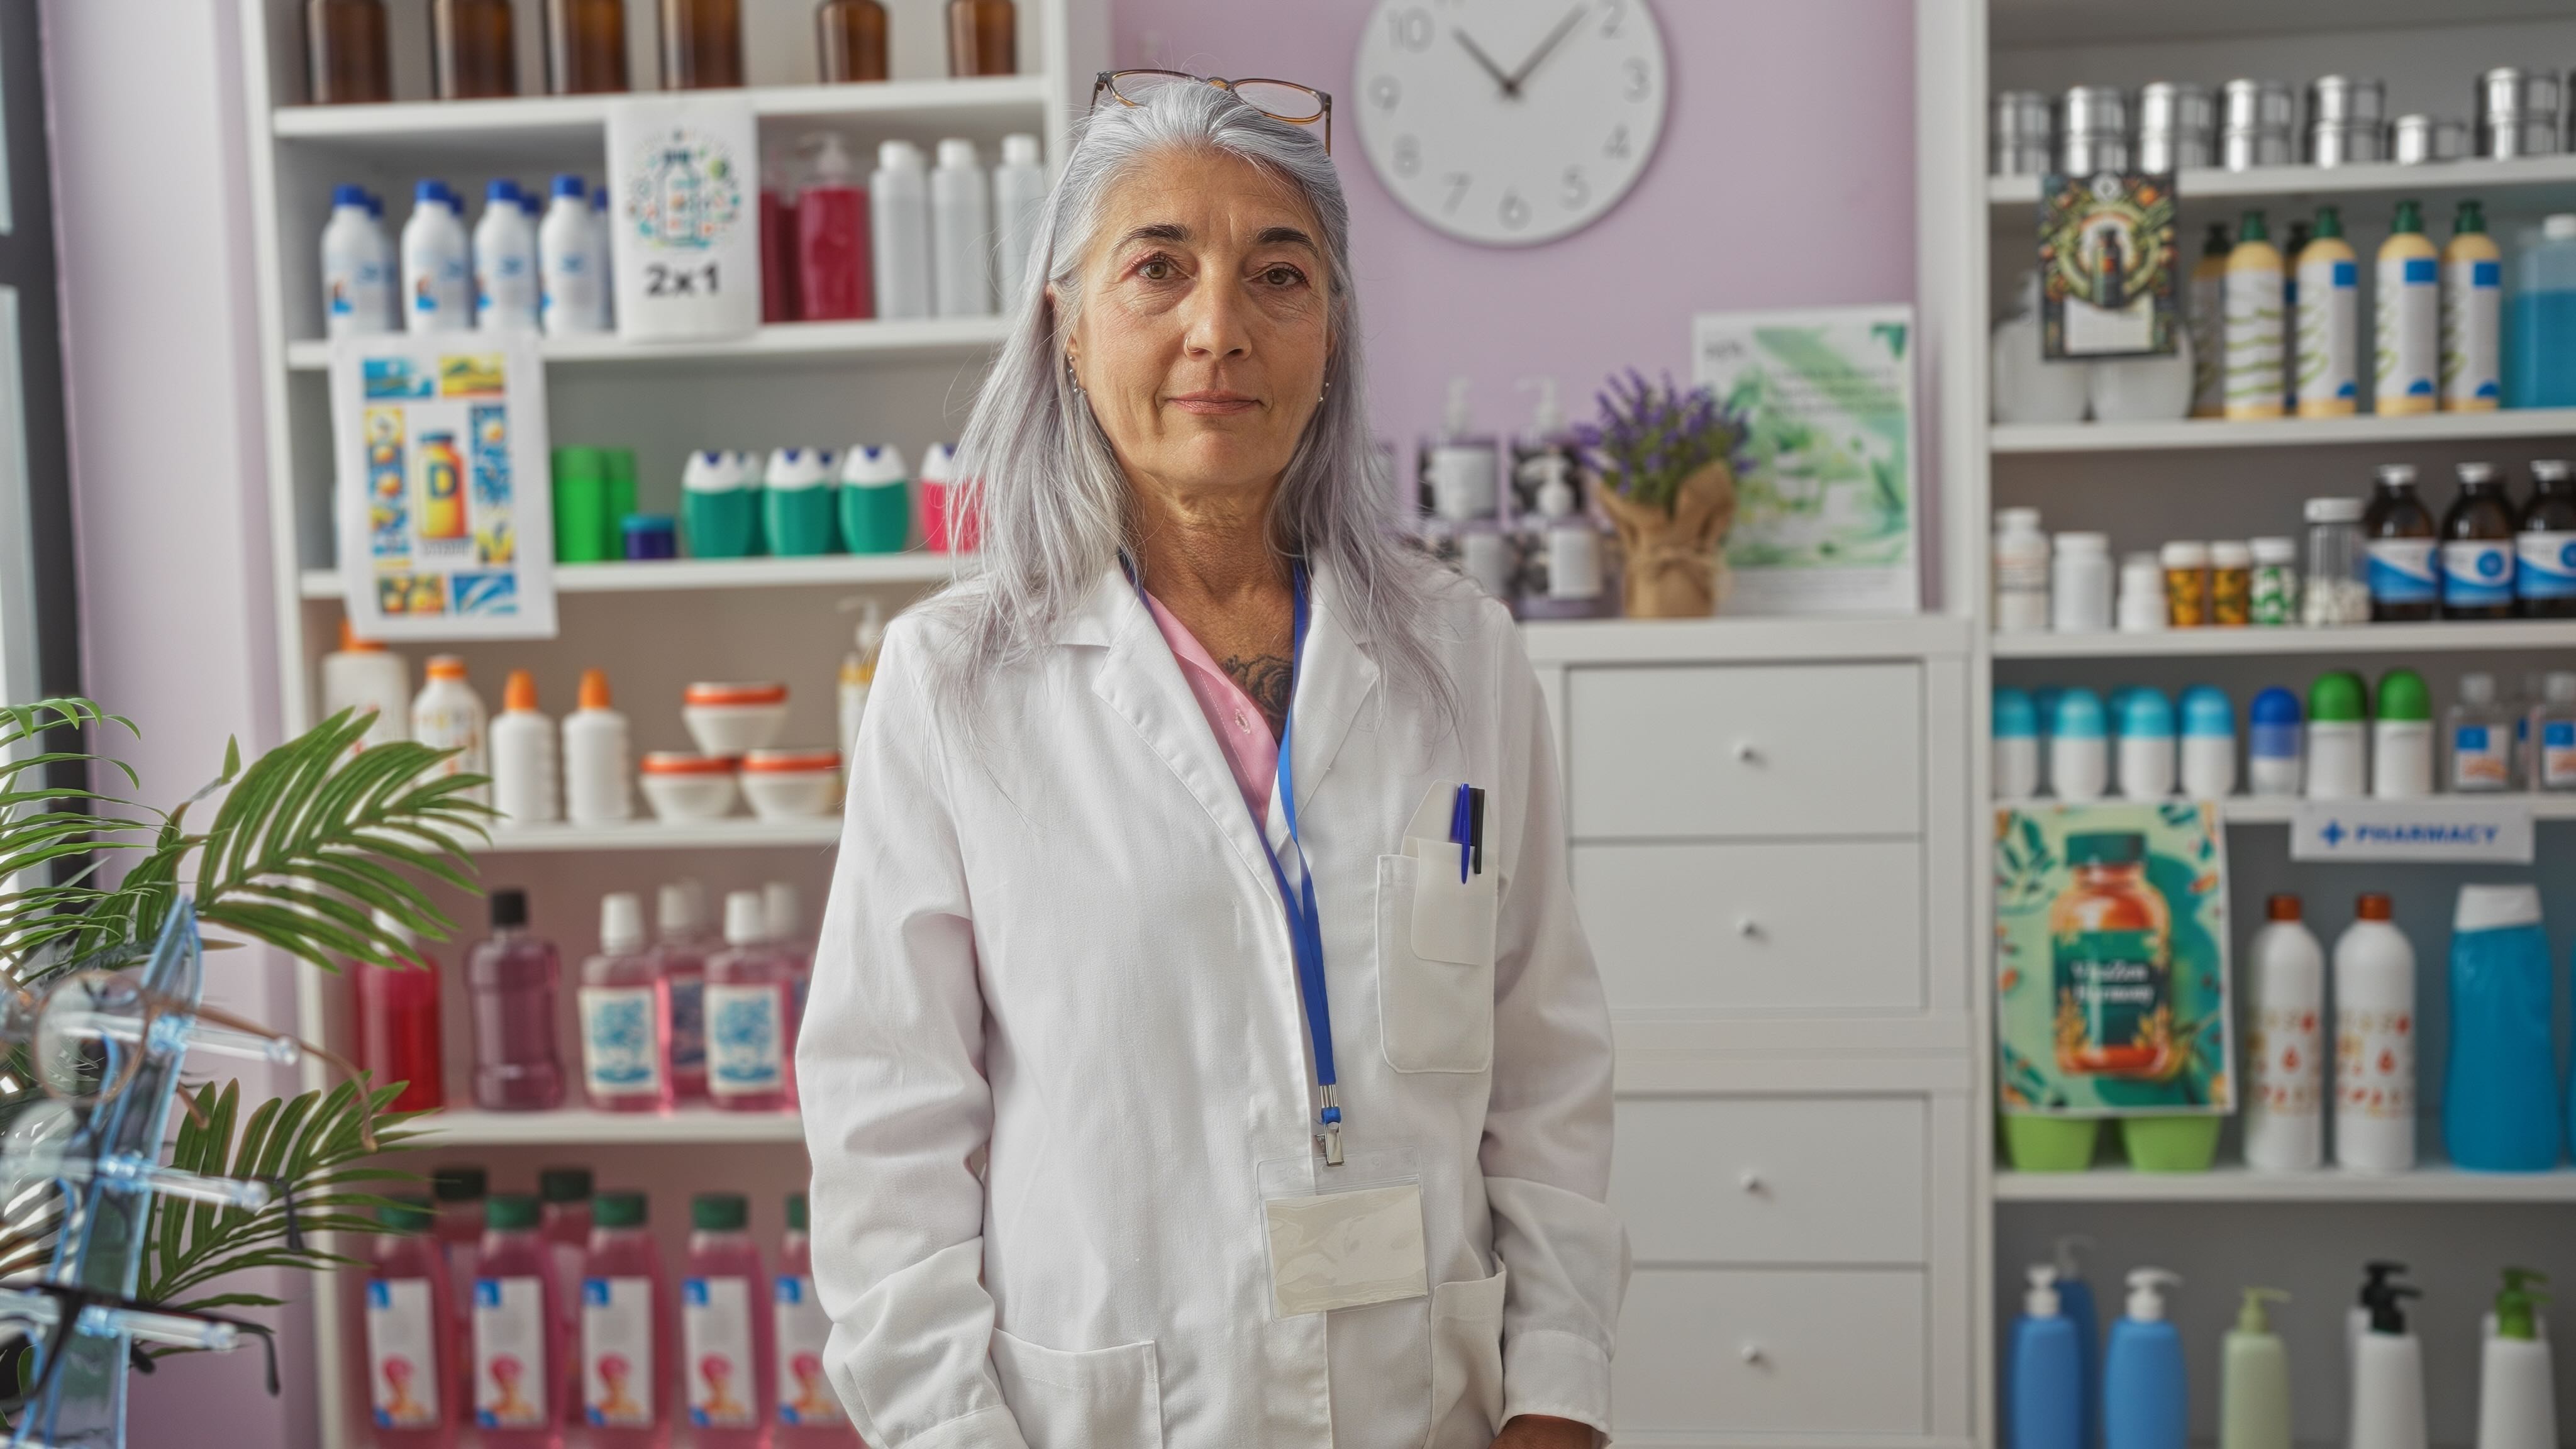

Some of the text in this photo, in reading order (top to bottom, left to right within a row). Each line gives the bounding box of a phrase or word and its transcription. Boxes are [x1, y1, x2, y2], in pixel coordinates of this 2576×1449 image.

[1387, 6, 1435, 53] 10
[1599, 0, 1628, 39] 2
[1367, 72, 1402, 119] 9
[1623, 55, 1652, 103] 3
[1392, 132, 1422, 180] 8
[1602, 123, 1631, 160] 4
[1442, 170, 1474, 217] 7
[1497, 187, 1532, 231] 6
[1557, 163, 1591, 212] 5
[643, 260, 720, 299] 2x1
[428, 462, 457, 500] D
[2356, 824, 2500, 845] PHARMACY
